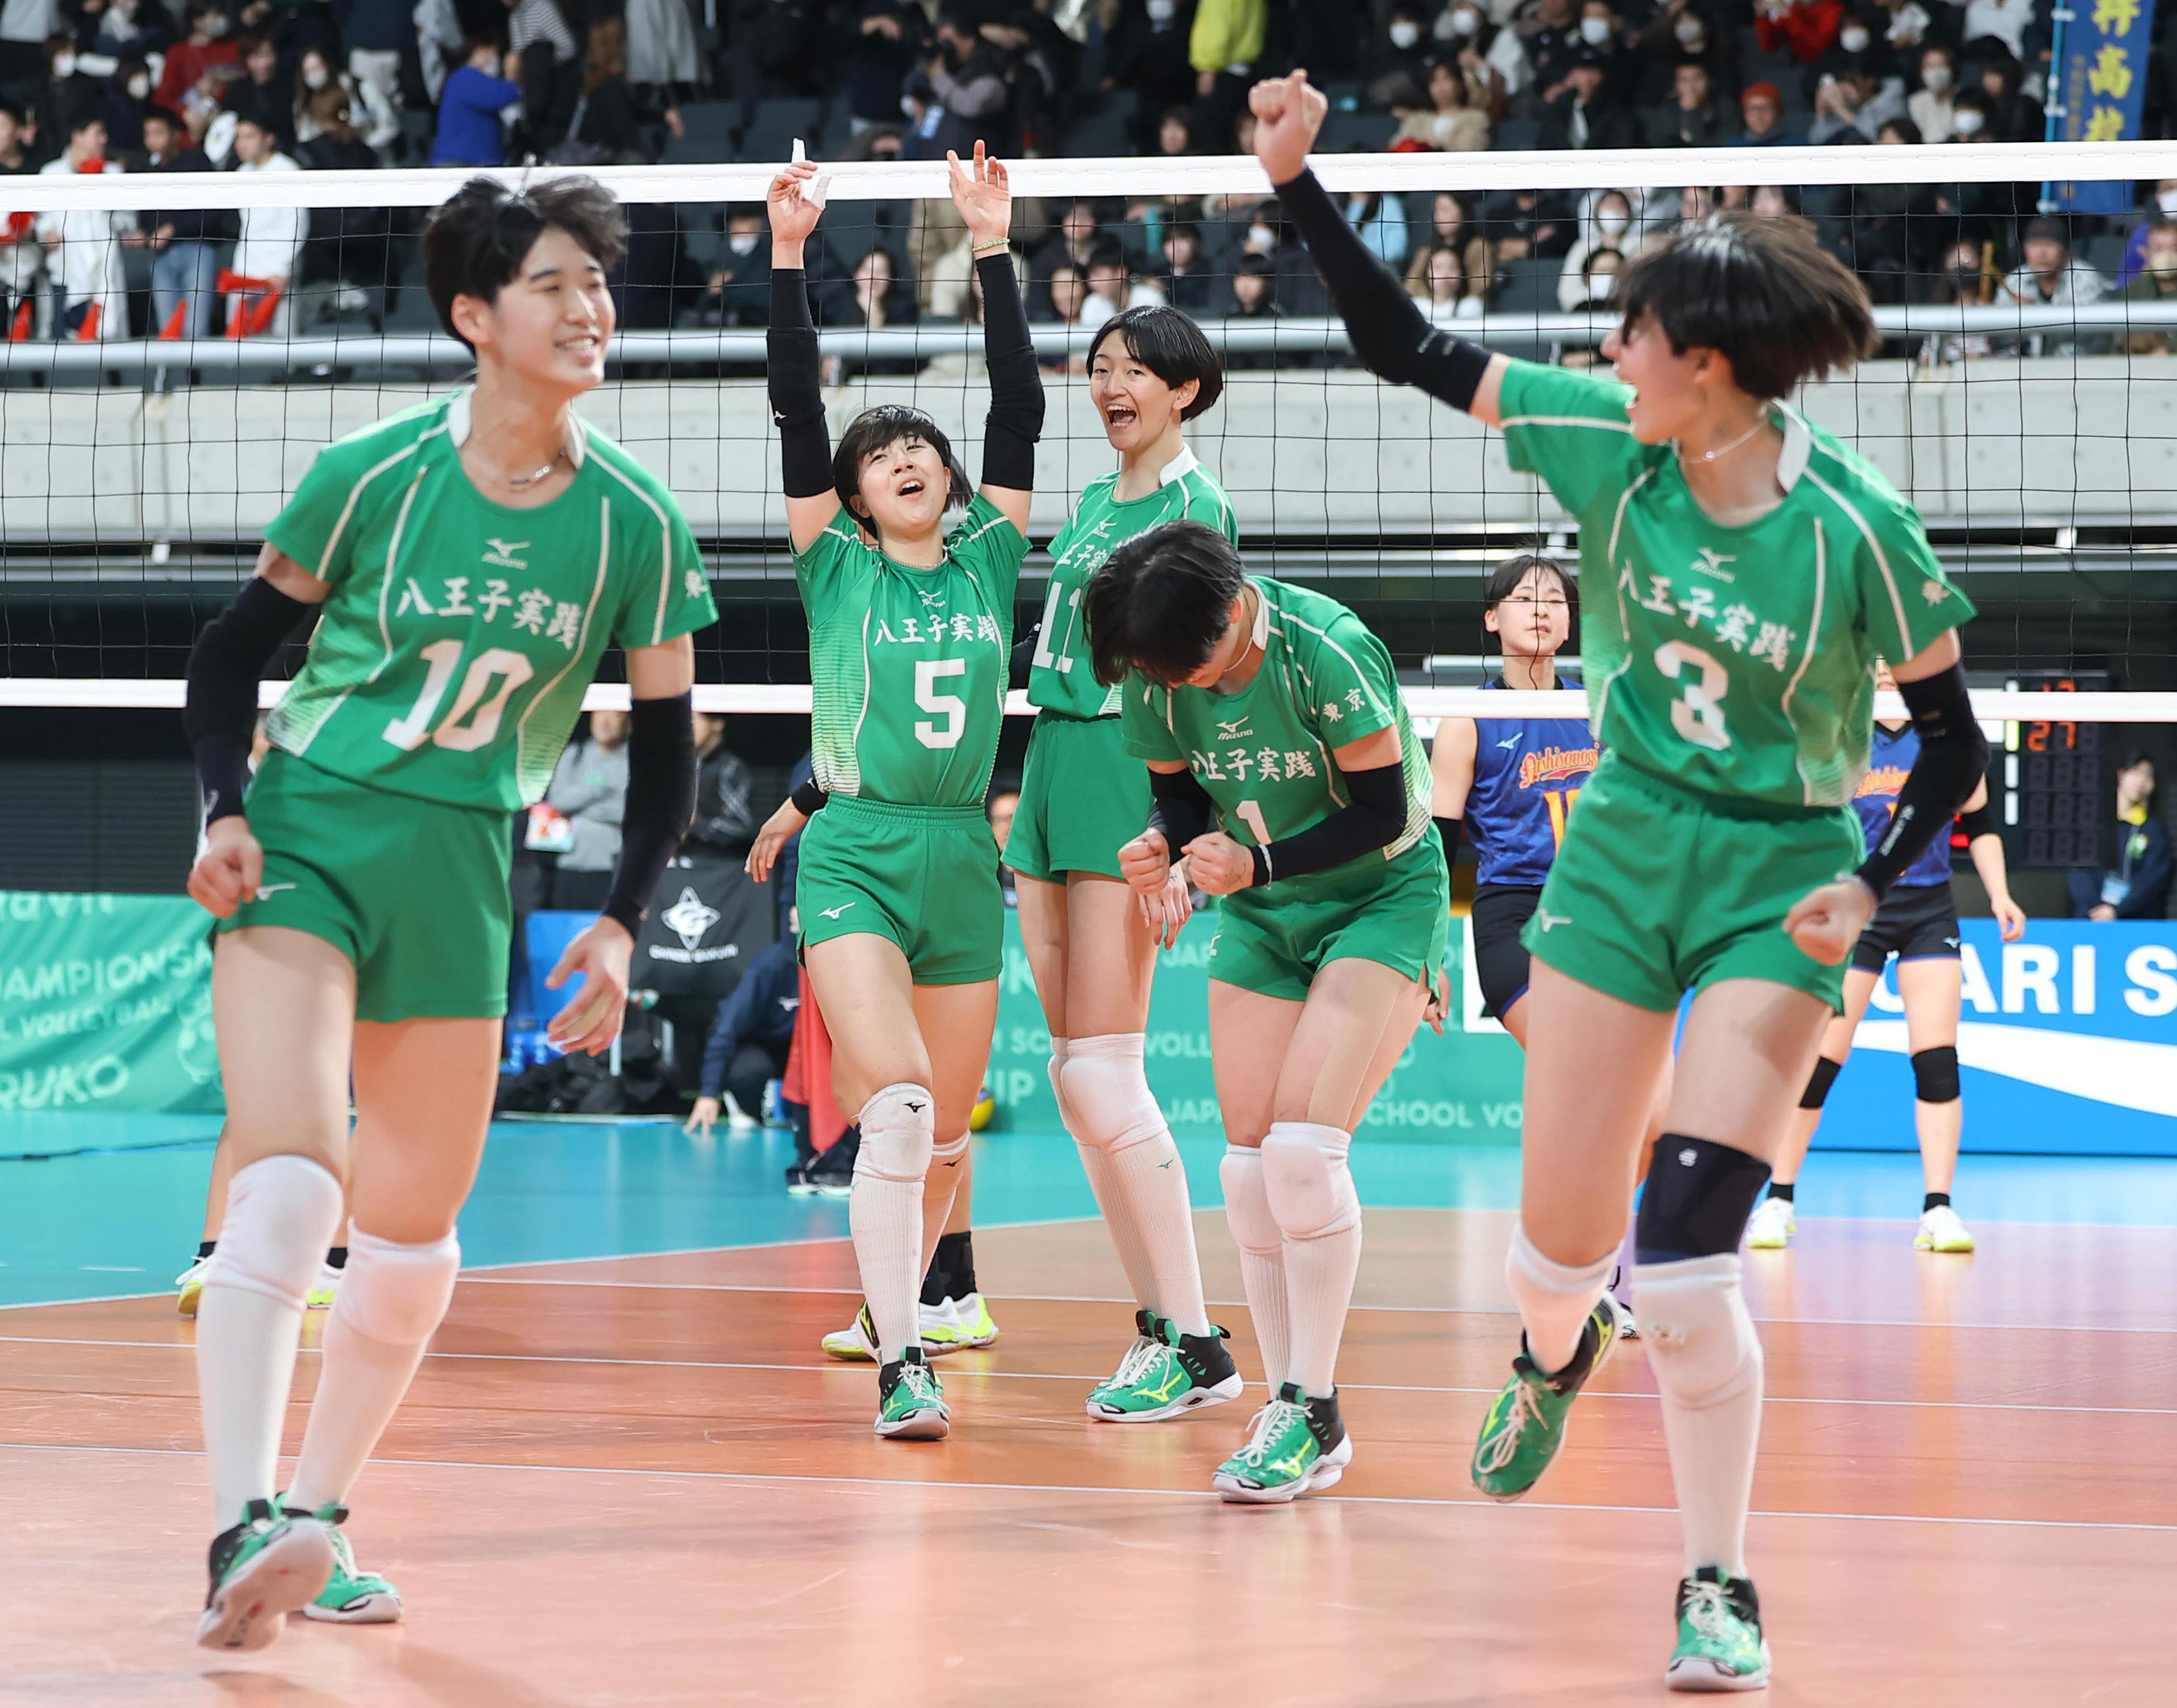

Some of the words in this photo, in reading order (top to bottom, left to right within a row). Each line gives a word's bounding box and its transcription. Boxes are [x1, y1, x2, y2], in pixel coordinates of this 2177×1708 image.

[394, 575, 581, 651] 八王子実践
[873, 611, 999, 647] 八王子実践
[381, 638, 534, 752] 10
[914, 658, 967, 750] 5
[1322, 687, 1366, 724] 東京
[1654, 638, 1731, 751] 3
[1234, 800, 1273, 844] 1
